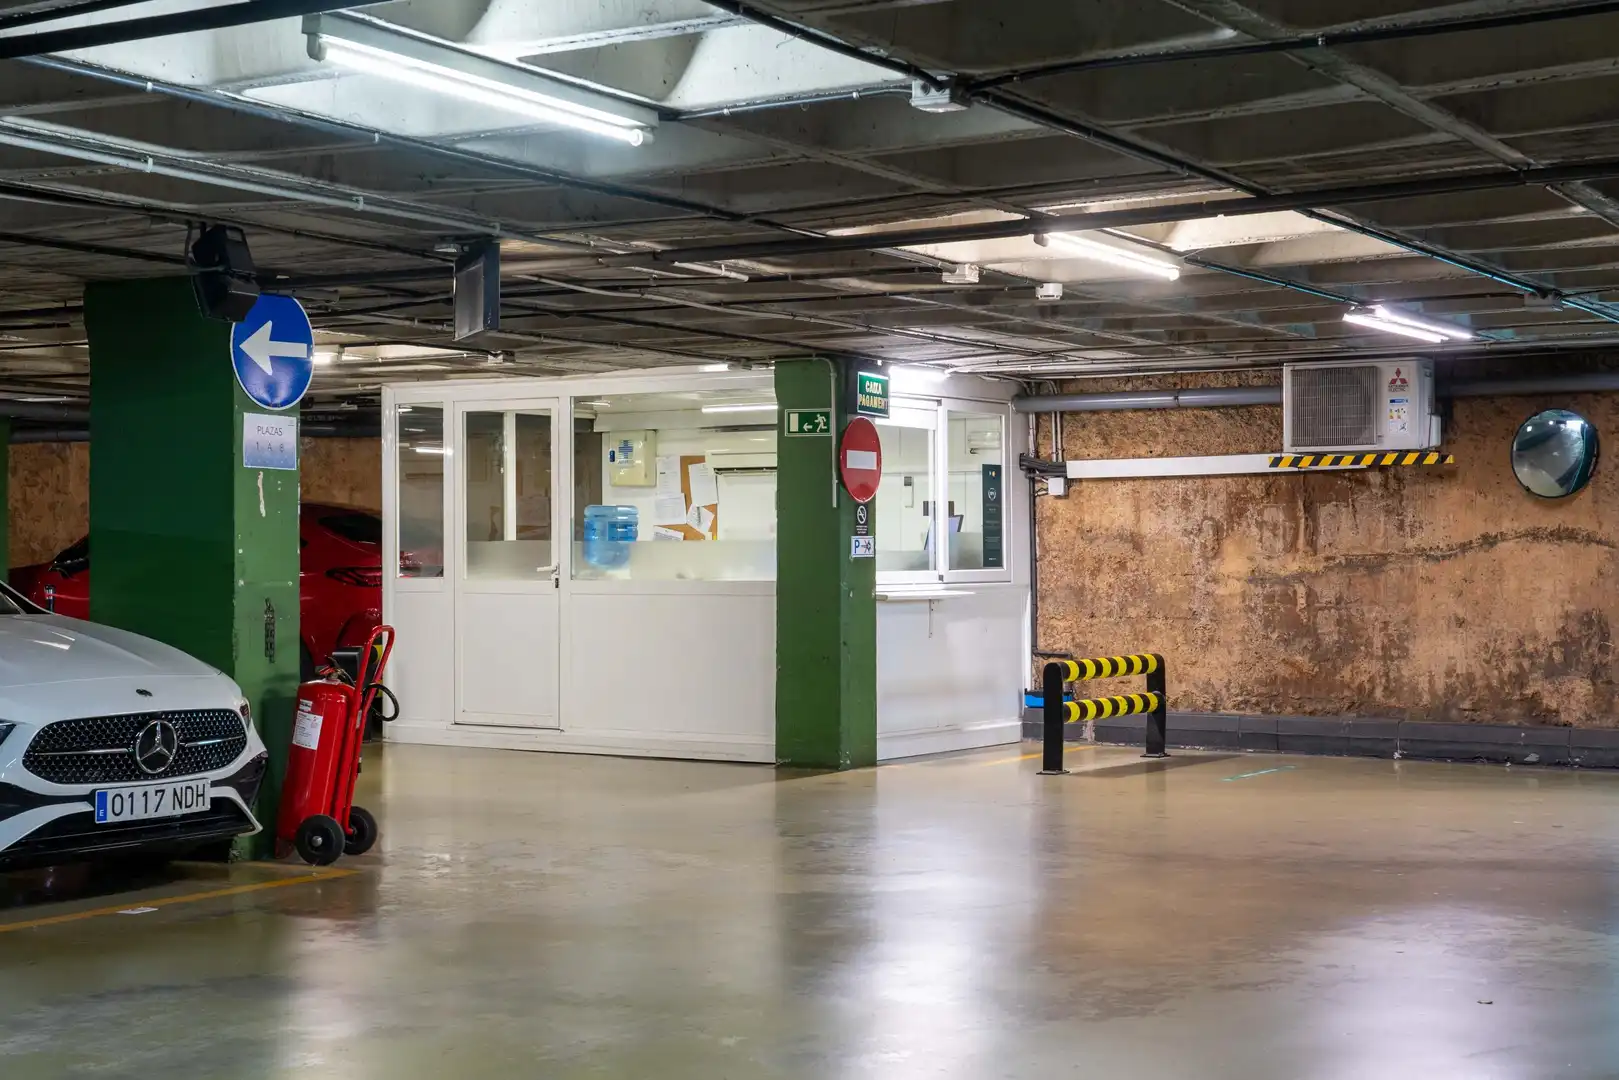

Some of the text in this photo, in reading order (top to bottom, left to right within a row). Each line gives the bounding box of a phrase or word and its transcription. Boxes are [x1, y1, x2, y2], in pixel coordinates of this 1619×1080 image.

[256, 425, 283, 437] PLAZAS
[256, 441, 259, 451] 1
[267, 442, 273, 452] A
[854, 539, 860, 554] P
[112, 783, 206, 817] 0117 NDH
[99, 809, 105, 817] E
